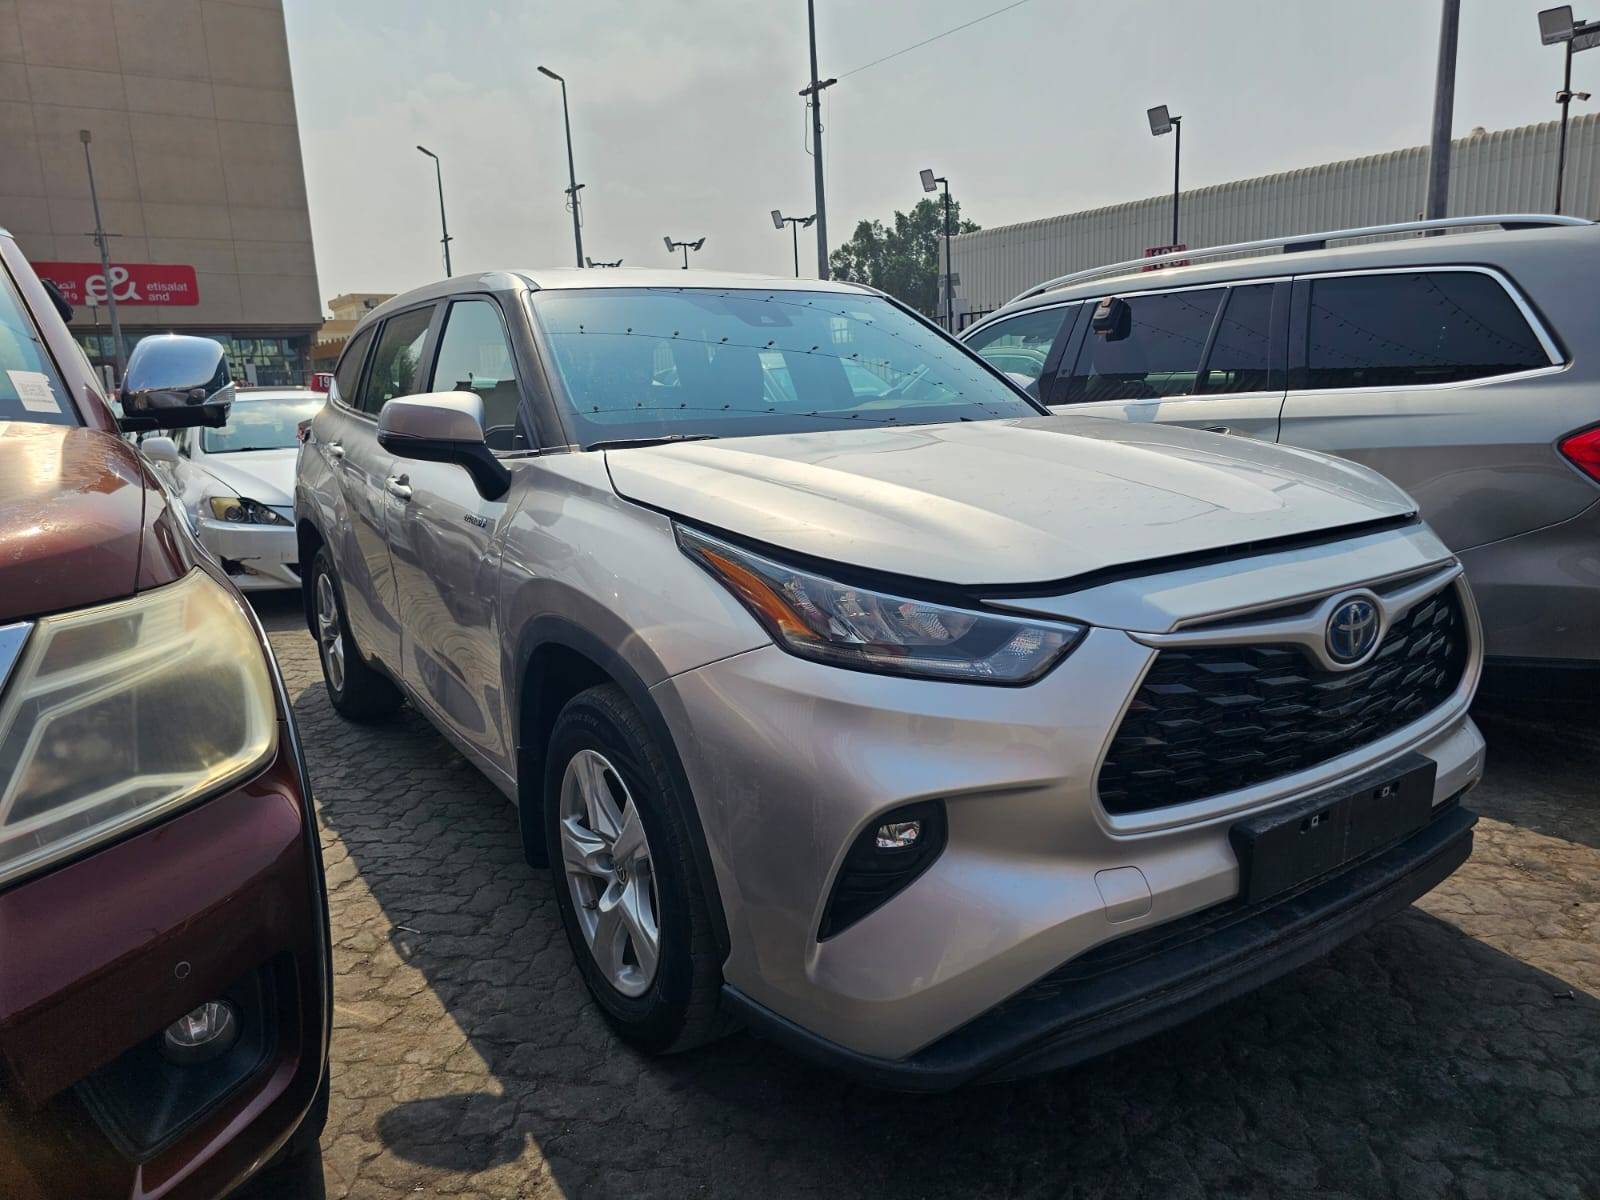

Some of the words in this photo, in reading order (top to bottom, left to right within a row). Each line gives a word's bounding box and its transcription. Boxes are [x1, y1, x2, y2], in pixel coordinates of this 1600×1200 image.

[147, 282, 188, 291] etisalat
[149, 293, 170, 301] and
[319, 375, 330, 388] 19
